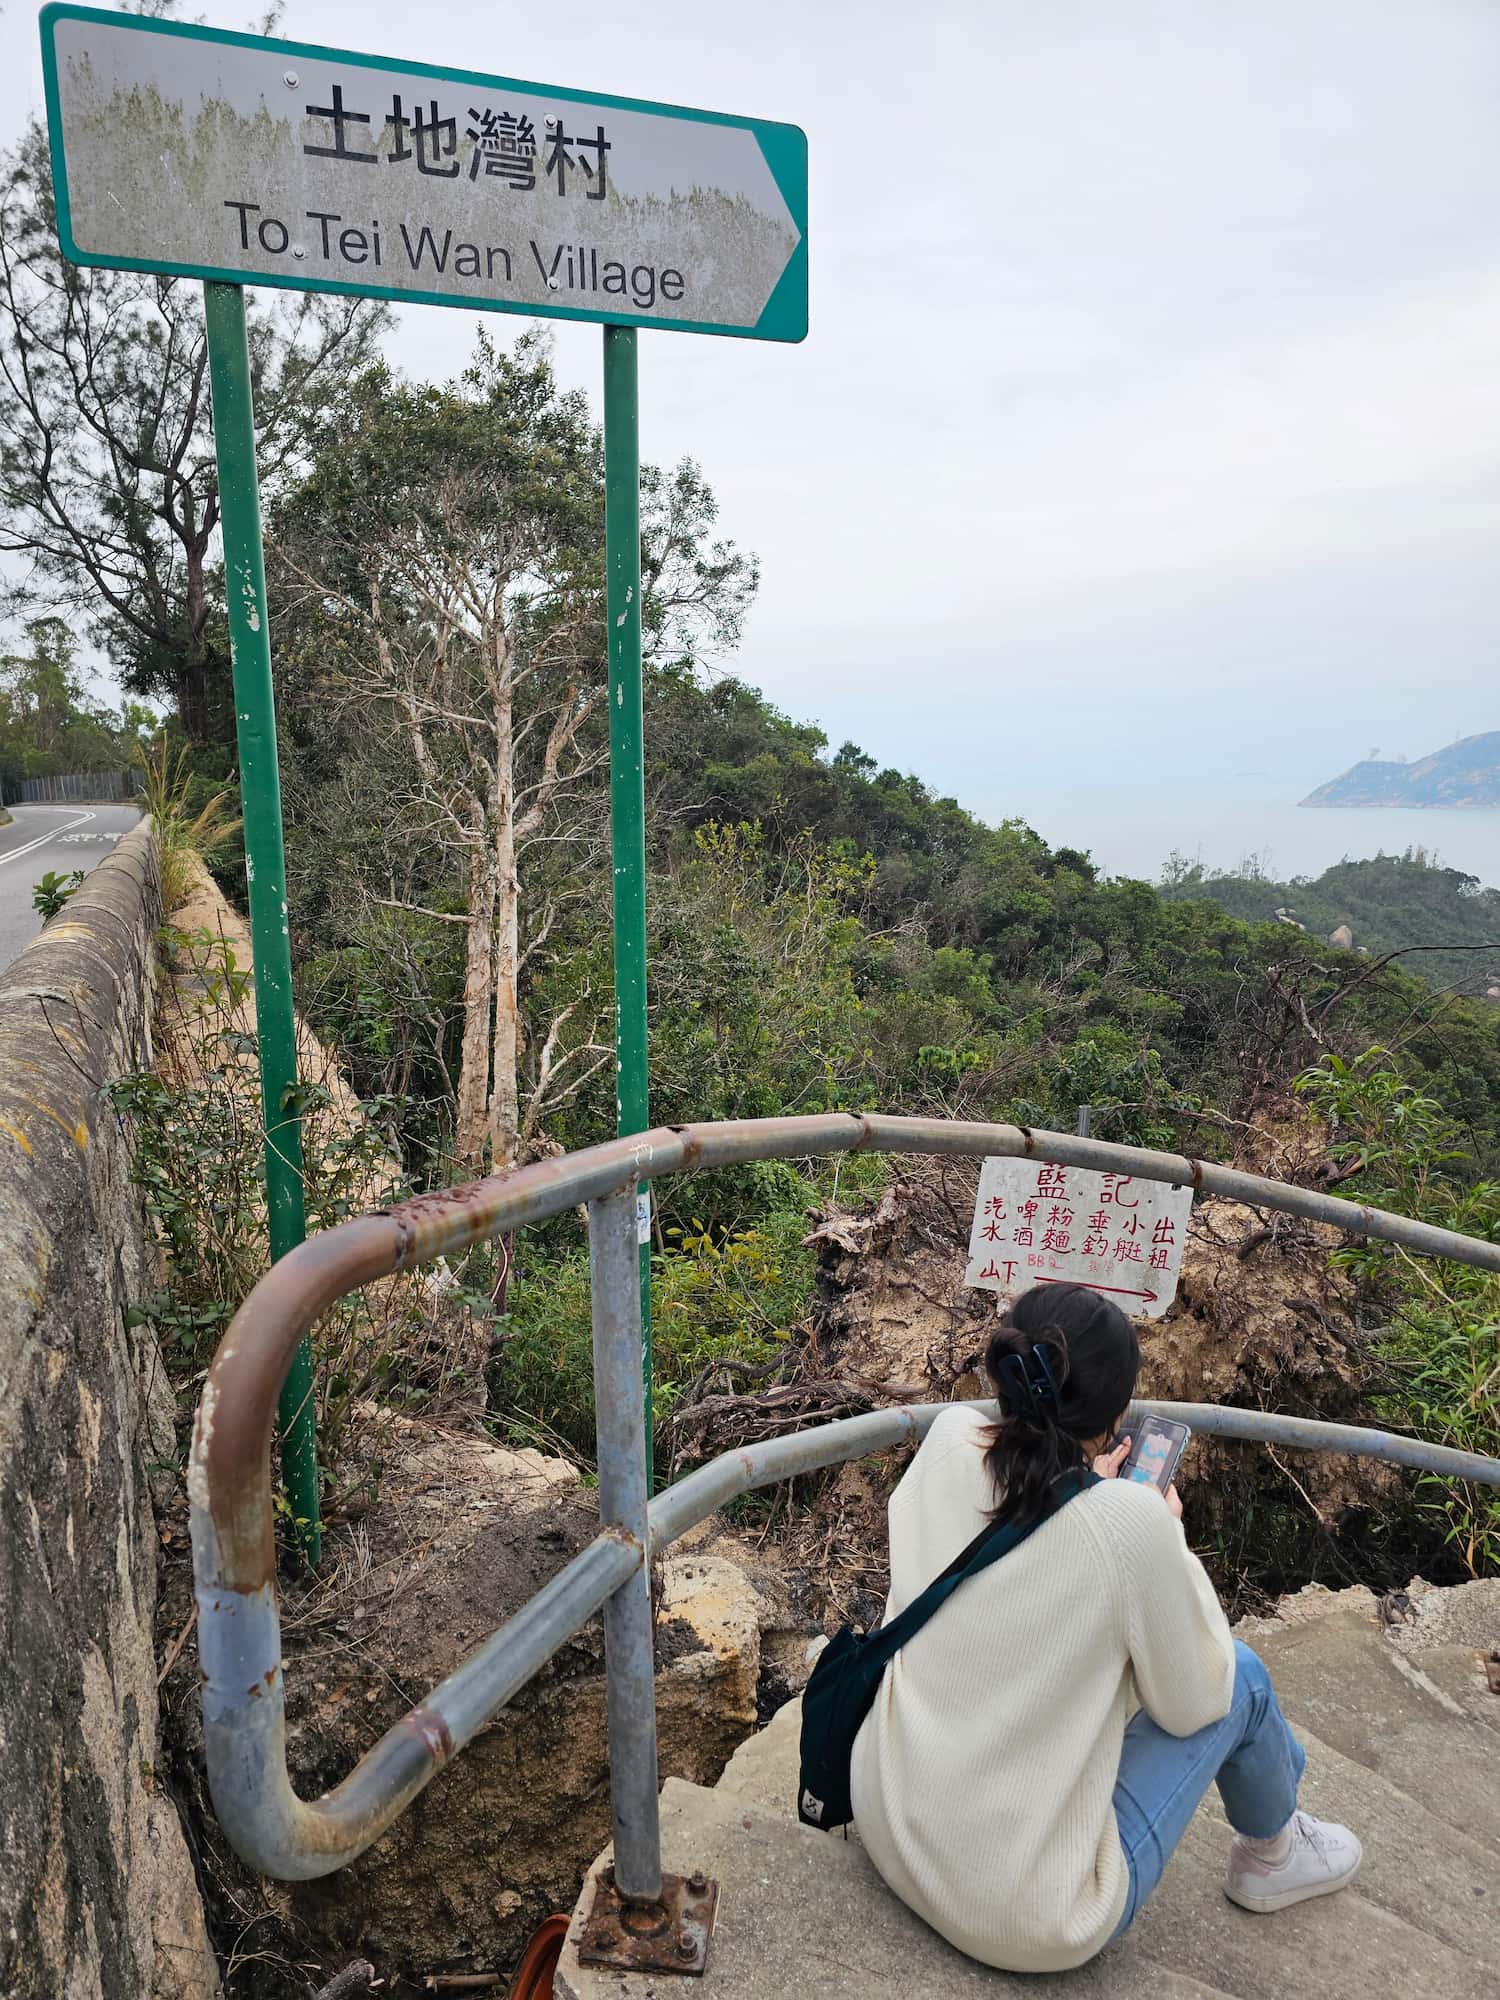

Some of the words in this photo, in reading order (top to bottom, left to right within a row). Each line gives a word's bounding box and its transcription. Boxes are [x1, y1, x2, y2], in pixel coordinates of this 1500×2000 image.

[303, 84, 612, 201] 土地灣村
[224, 200, 290, 255] To
[306, 211, 382, 268] Tei
[399, 223, 512, 282] Wan
[528, 239, 686, 308] Village
[979, 1258, 1019, 1284] 山下
